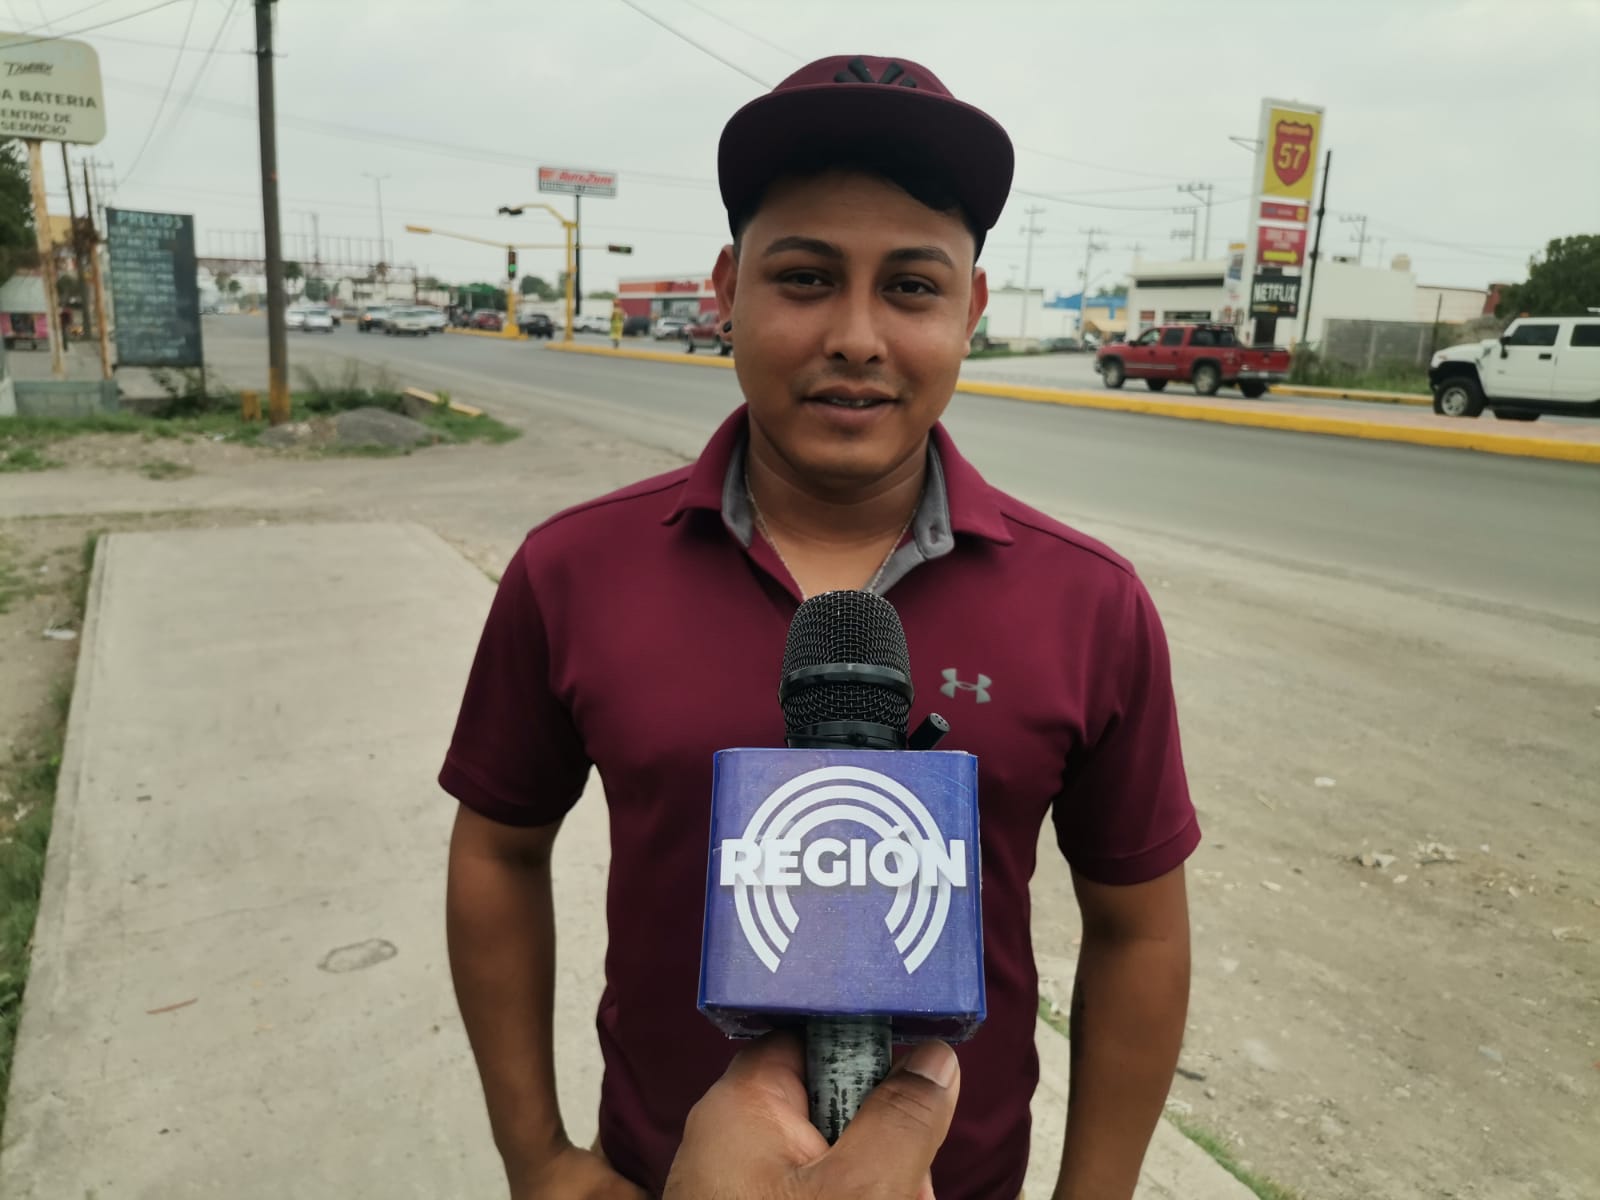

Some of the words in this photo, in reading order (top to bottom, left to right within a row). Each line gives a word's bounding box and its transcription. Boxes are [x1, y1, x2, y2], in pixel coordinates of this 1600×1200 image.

[19, 89, 98, 109] BATERIA
[0, 121, 68, 136] SERVICIO
[54, 112, 73, 124] DE
[1278, 142, 1306, 170] 57
[1253, 282, 1297, 304] NETFLIX
[719, 823, 967, 888] REGIÓN
